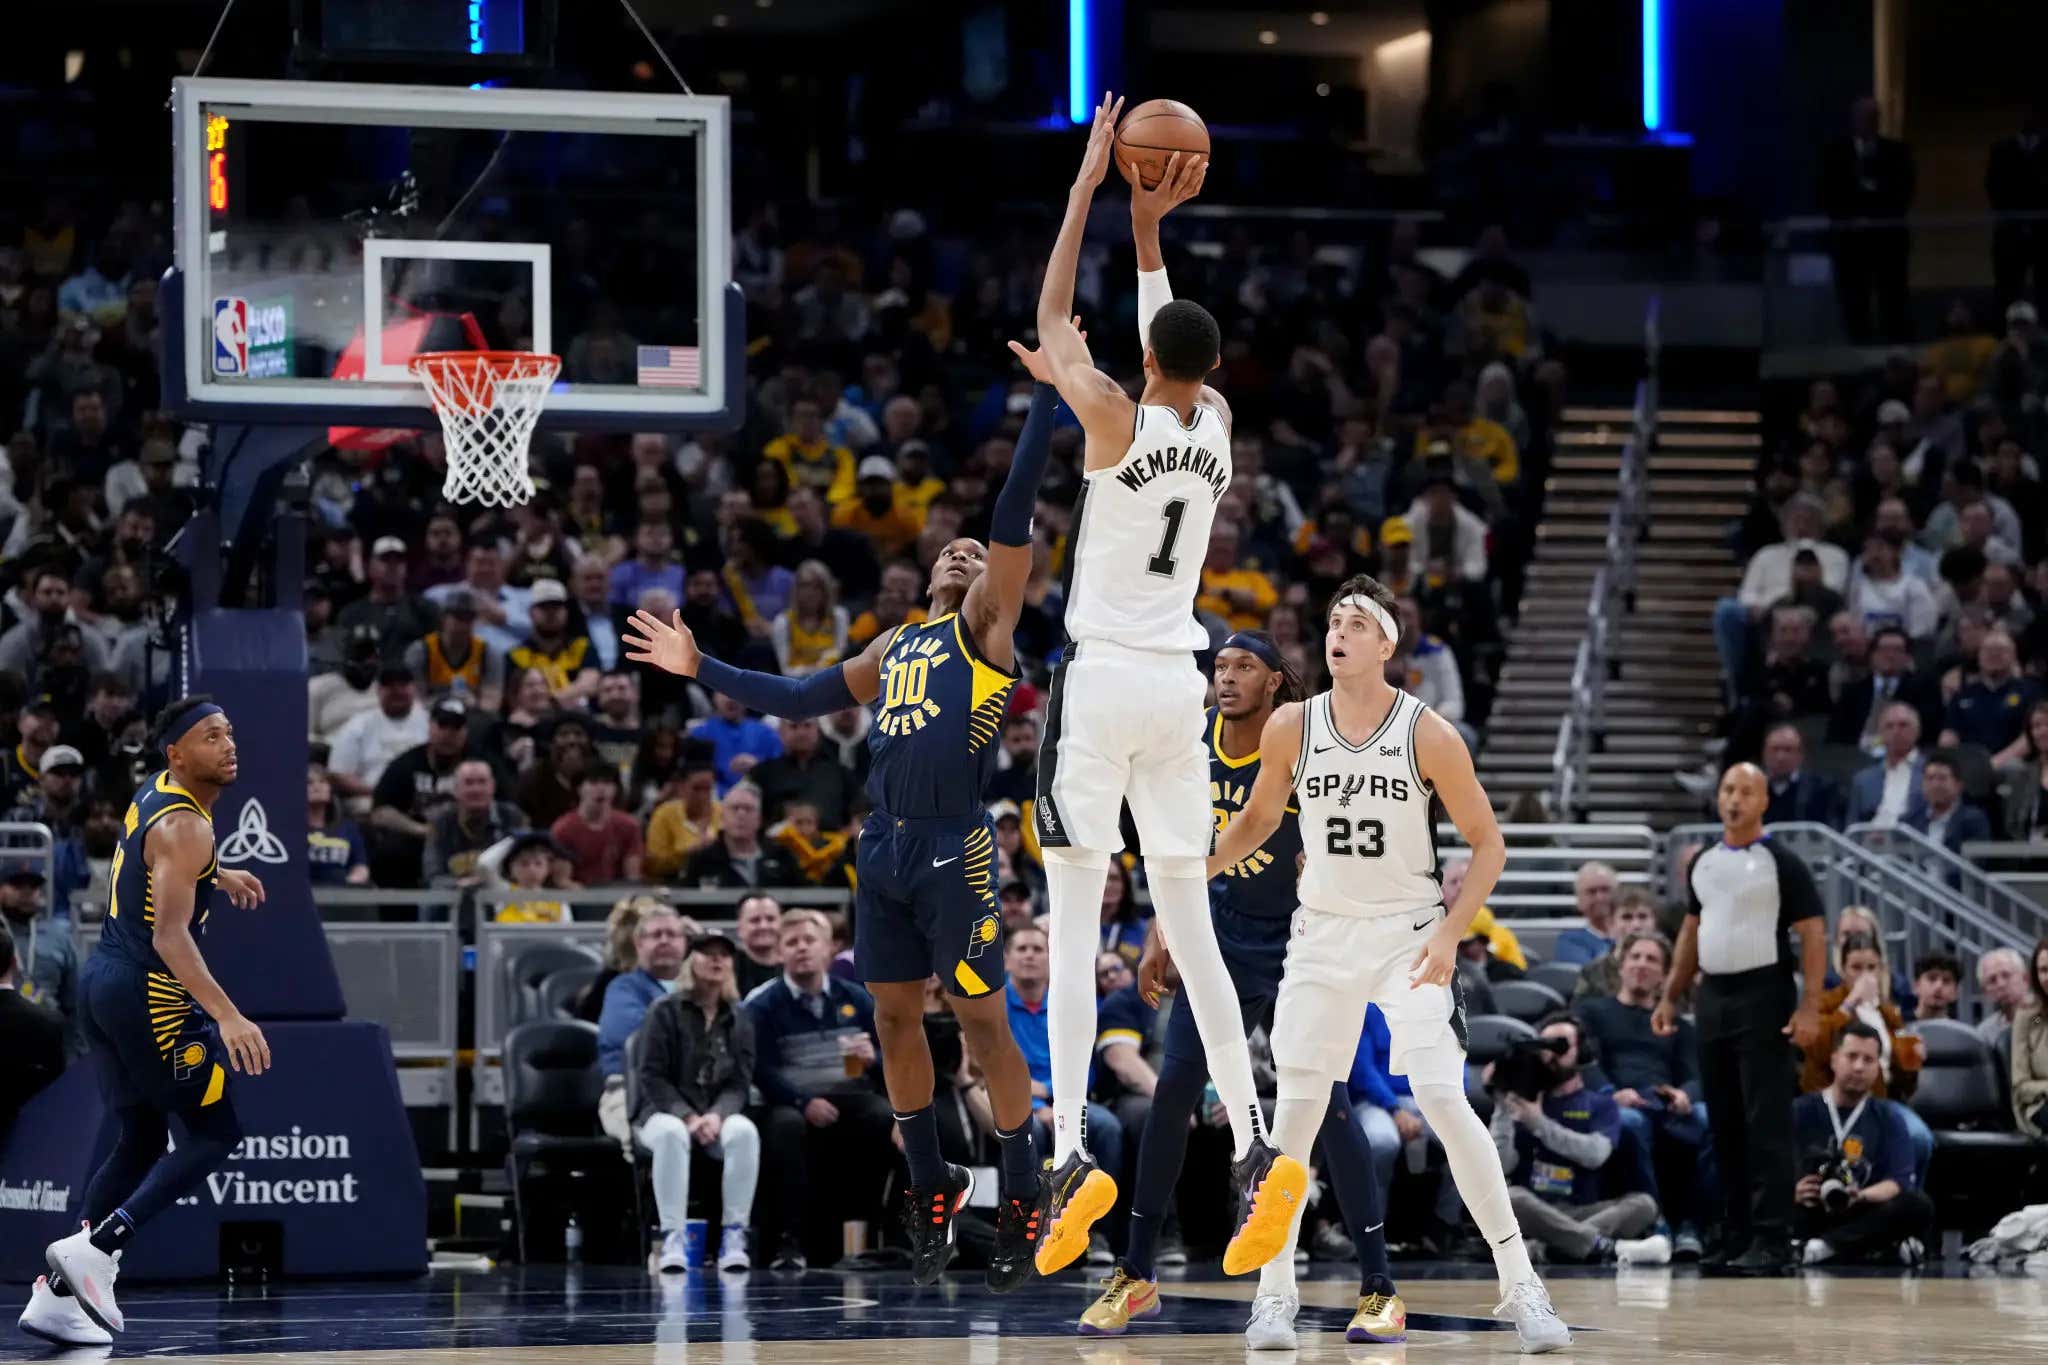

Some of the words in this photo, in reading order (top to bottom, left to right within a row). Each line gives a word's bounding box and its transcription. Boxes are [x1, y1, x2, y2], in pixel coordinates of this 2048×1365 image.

[1116, 446, 1227, 504] WEMBANYAMA
[1146, 496, 1190, 580] 1
[885, 657, 929, 709] 00
[1379, 746, 1403, 757] Self.
[1306, 773, 1409, 808] SPURS
[1326, 816, 1386, 858] 23
[206, 1171, 359, 1205] Vincent
